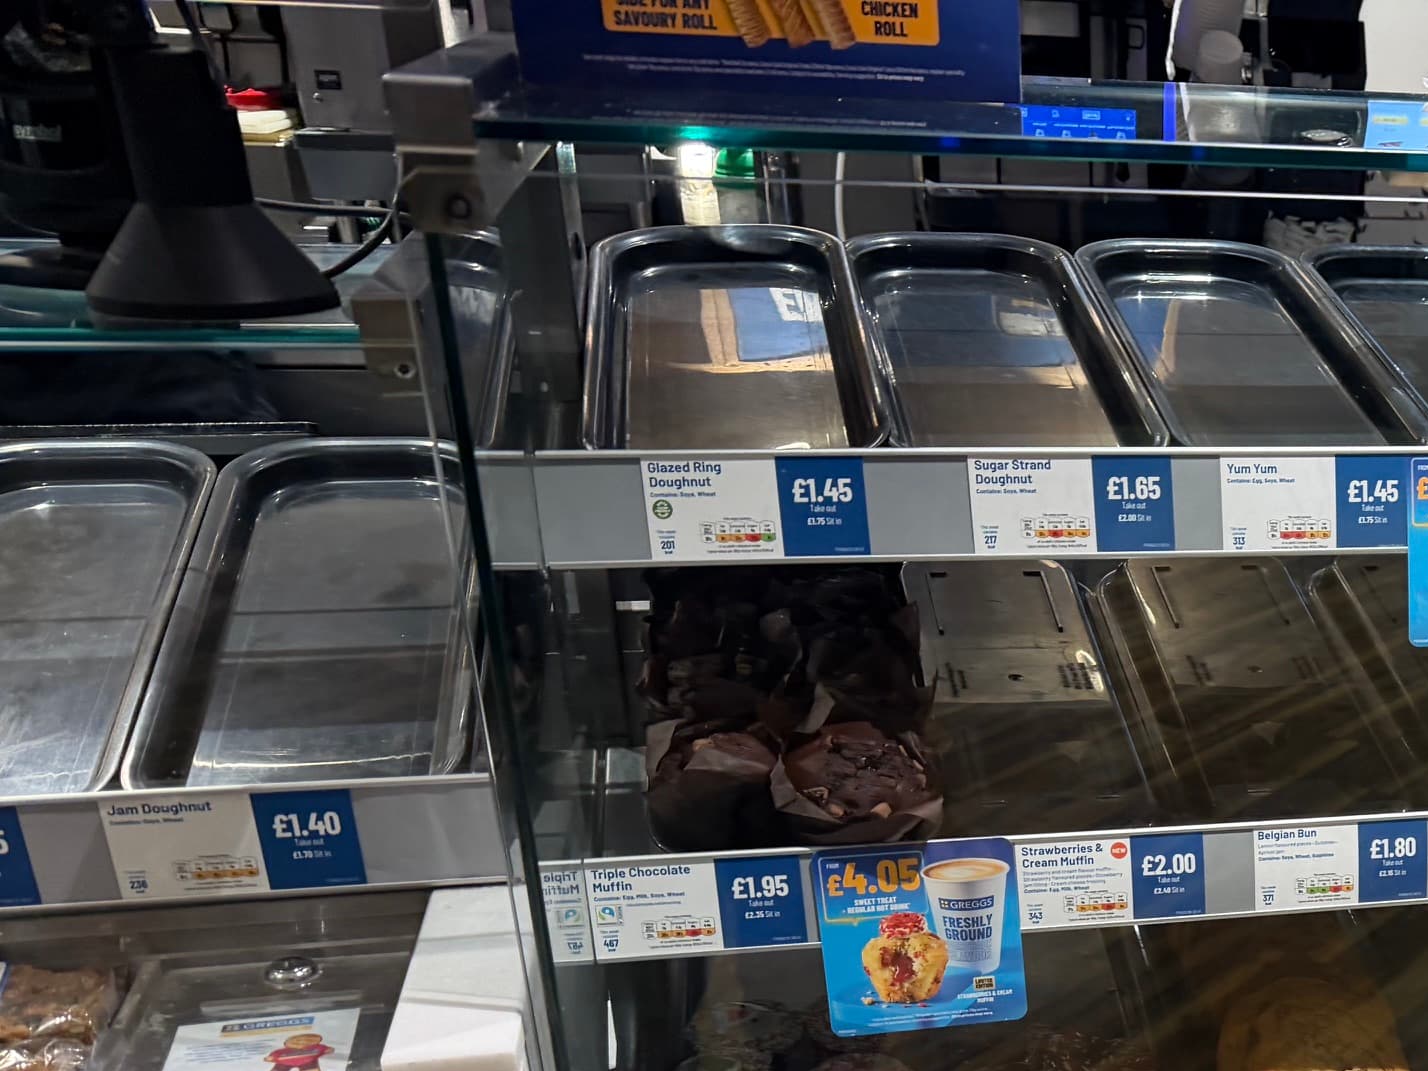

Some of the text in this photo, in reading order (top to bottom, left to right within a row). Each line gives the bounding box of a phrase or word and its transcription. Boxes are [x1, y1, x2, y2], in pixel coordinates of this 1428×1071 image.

[861, 1, 918, 18] CHICKEN
[614, 10, 717, 30] SAVOURY ROLL
[875, 21, 908, 37] ROLL
[647, 462, 721, 475] Glazed Ring
[975, 459, 1051, 473] Sugar Strand
[1227, 463, 1277, 474] Yum Yum
[649, 476, 712, 490] Doughnut
[976, 474, 1033, 486] Doughnut
[792, 478, 853, 503] £1.45
[1107, 476, 1161, 500] £1.65
[1348, 479, 1399, 503] £1.45
[810, 504, 836, 513] Take out
[1362, 504, 1374, 512] Take
[660, 540, 675, 550] 201
[985, 536, 997, 544] 217
[1233, 537, 1246, 545] 313
[107, 801, 212, 817] Jam Doughnut
[272, 811, 341, 839] £1.40
[1258, 829, 1317, 841] Belgian Bun
[1022, 843, 1103, 857] Strawberries &
[1370, 837, 1416, 860] £1.80
[1023, 856, 1094, 868] Cream Muffin
[1142, 853, 1196, 876] £2.00
[591, 865, 691, 882] Triple Chocolate
[827, 858, 921, 897] £4.05
[593, 881, 633, 894] Muffin
[732, 875, 789, 900] £1.95
[950, 897, 992, 909] GREGGS
[1263, 894, 1274, 902] 371
[847, 906, 875, 914] REGULAR
[1028, 912, 1042, 920] 343
[942, 914, 993, 928] FRESHLY
[945, 927, 992, 941] GROUND
[603, 938, 619, 949] 467
[241, 1017, 311, 1031] GREGGS
